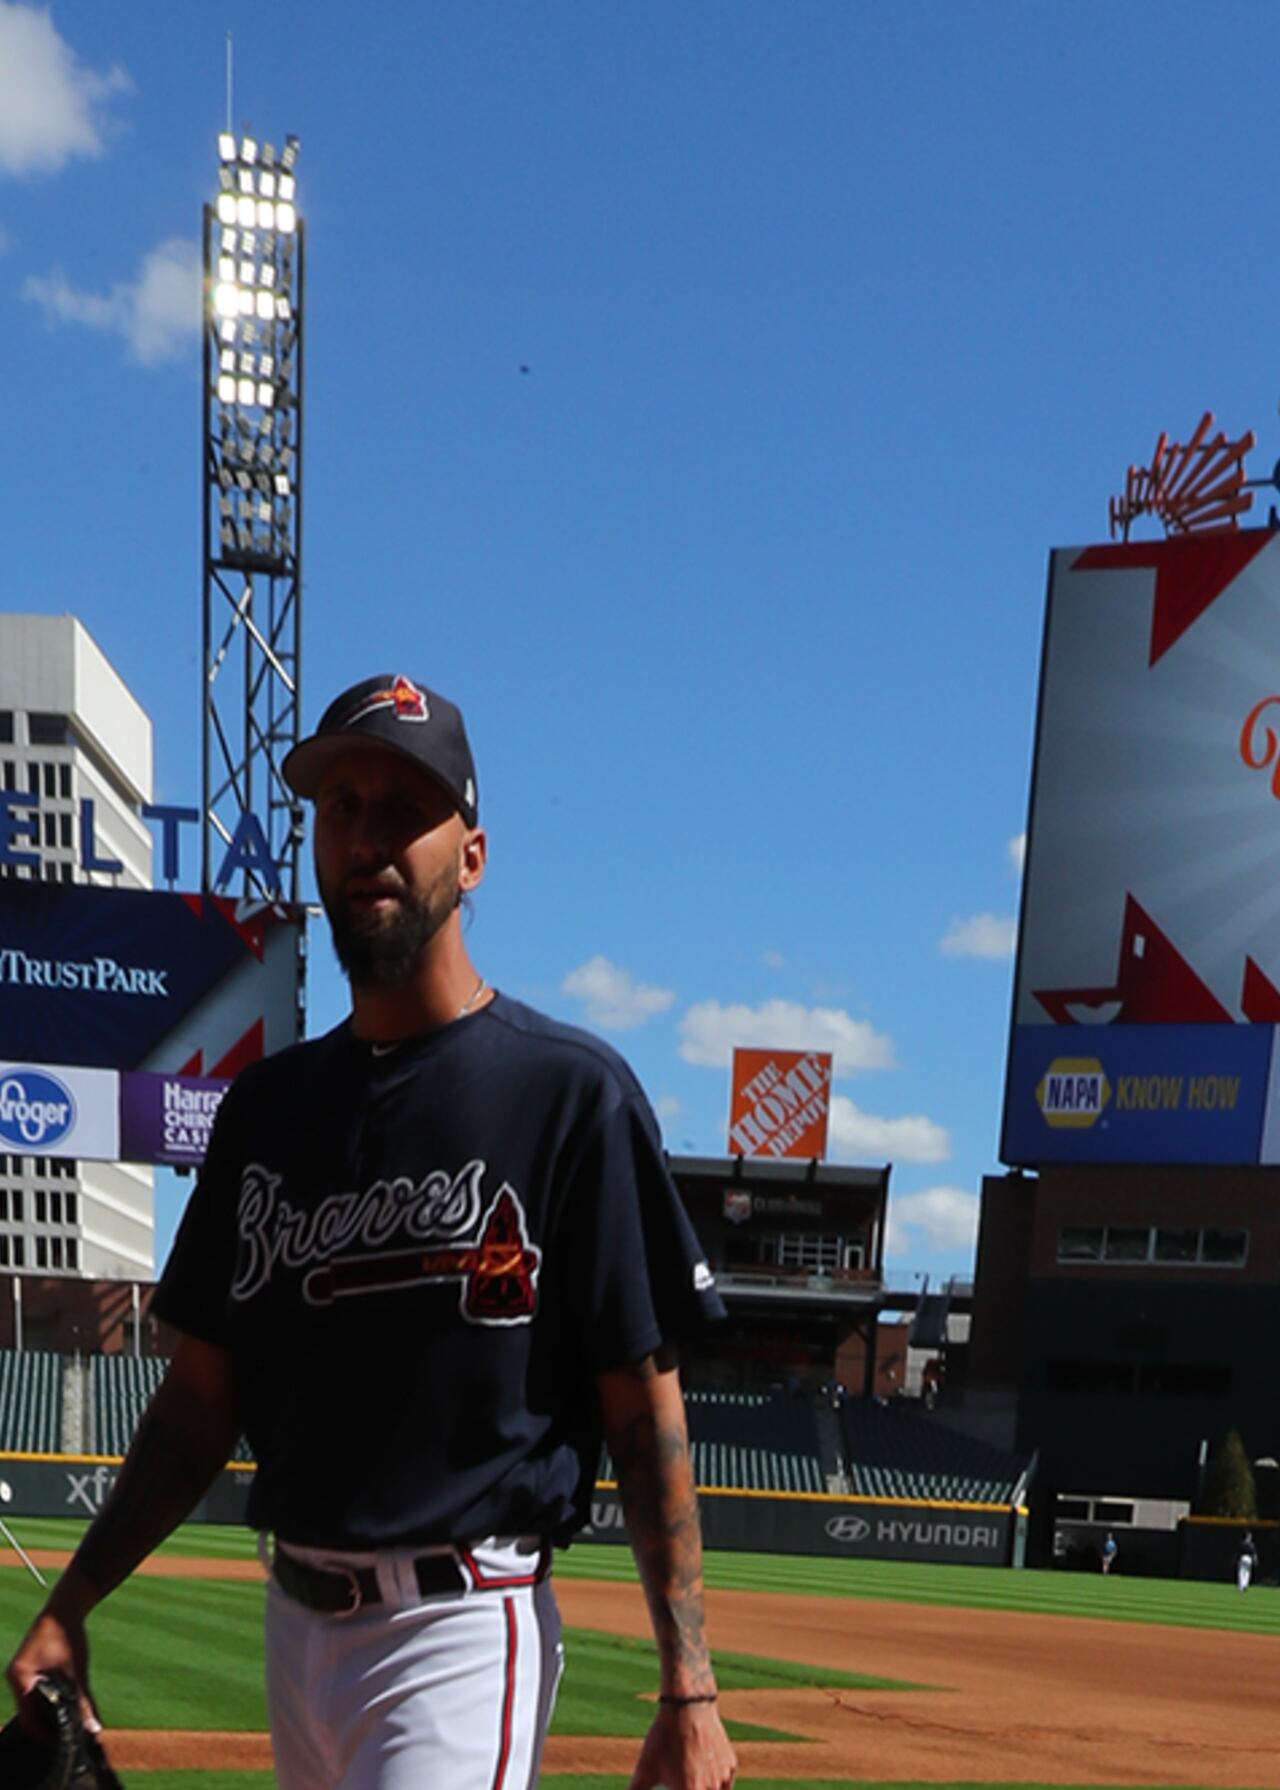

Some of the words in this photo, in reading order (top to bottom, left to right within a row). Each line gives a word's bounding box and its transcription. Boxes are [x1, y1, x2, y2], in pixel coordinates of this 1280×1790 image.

[94, 957, 169, 996] PARK
[730, 1051, 832, 1154] HOME
[740, 1060, 784, 1103] THE
[1046, 1074, 1102, 1111] NAPA
[1117, 1076, 1184, 1111] KNOW
[1188, 1076, 1240, 1111] HOW
[768, 1093, 828, 1157] DEPOT
[230, 1159, 486, 1300] Braves
[877, 1520, 999, 1548] HYUNDAI
